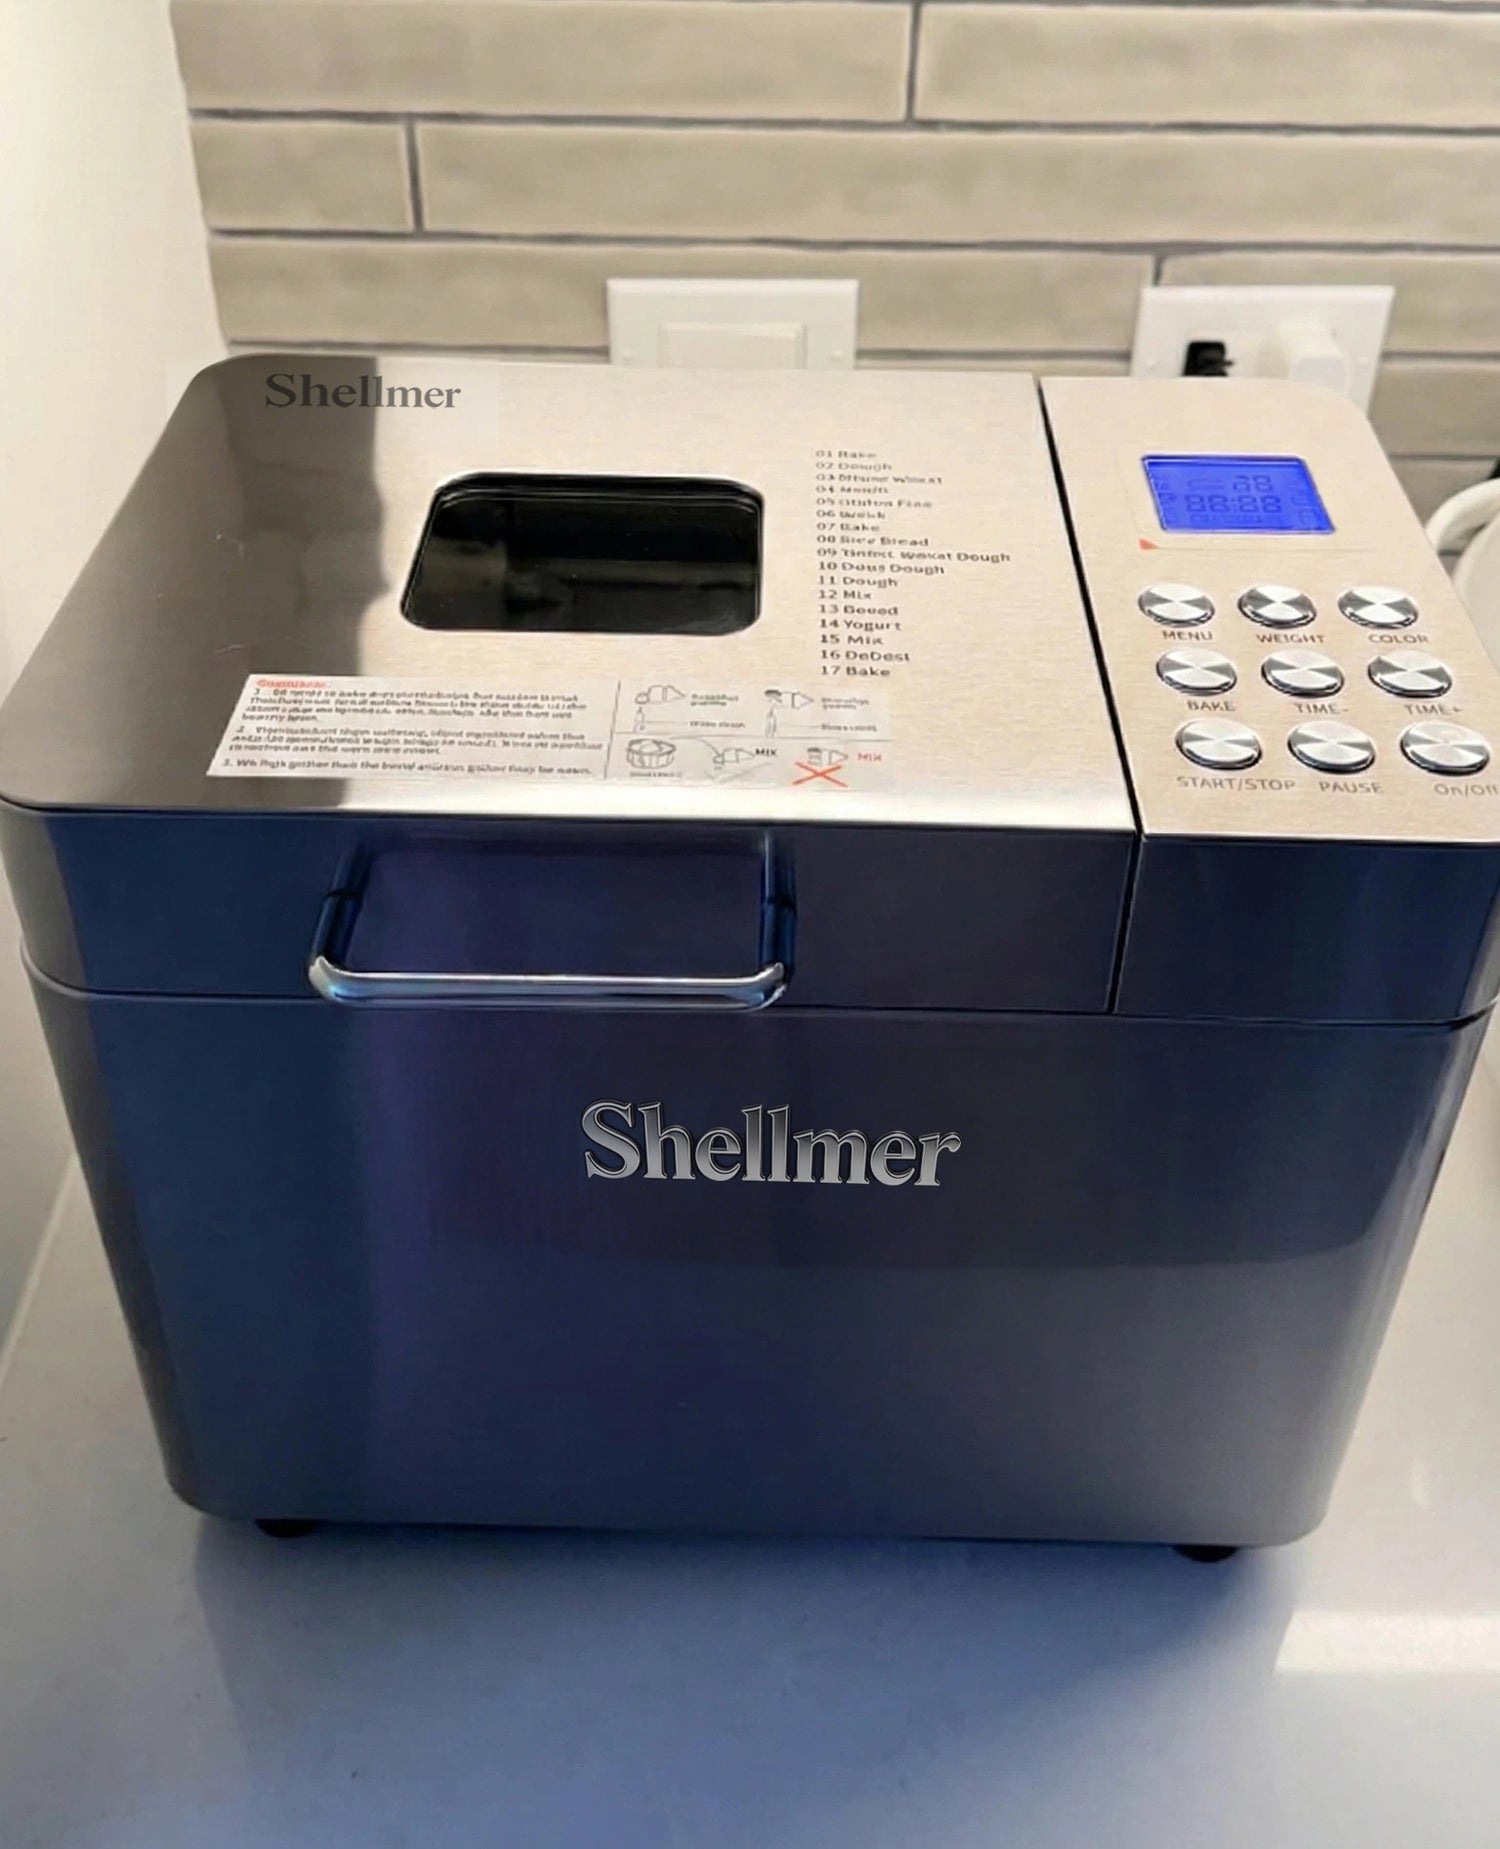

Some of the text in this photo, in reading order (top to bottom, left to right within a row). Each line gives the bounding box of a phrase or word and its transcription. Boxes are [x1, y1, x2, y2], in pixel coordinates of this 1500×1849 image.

[264, 370, 461, 410] Shellmer
[816, 450, 832, 458] 01
[816, 485, 834, 493] 04
[817, 510, 835, 518] 06
[817, 523, 836, 531] 07
[817, 549, 836, 557] 09
[957, 552, 1010, 563] Dough
[819, 562, 837, 570] 10
[890, 565, 945, 575] Dough
[819, 576, 898, 588] 11 Dough
[819, 590, 872, 600] 12 Mix
[819, 605, 838, 613] 13
[820, 619, 902, 632] 14 Yogurt
[821, 634, 840, 643] 15
[1162, 630, 1214, 641] MENU
[1255, 634, 1325, 644] WEIGHT
[1368, 633, 1430, 644] COLOR
[821, 650, 840, 659] 16
[821, 666, 890, 677] 17 Bake
[1187, 700, 1236, 712] BAKE
[1294, 703, 1349, 715] TIME-
[755, 748, 778, 757] MIX
[1176, 776, 1296, 792] START/STOP
[1319, 781, 1384, 795] PAUSE
[581, 1099, 962, 1190] Shellmer
